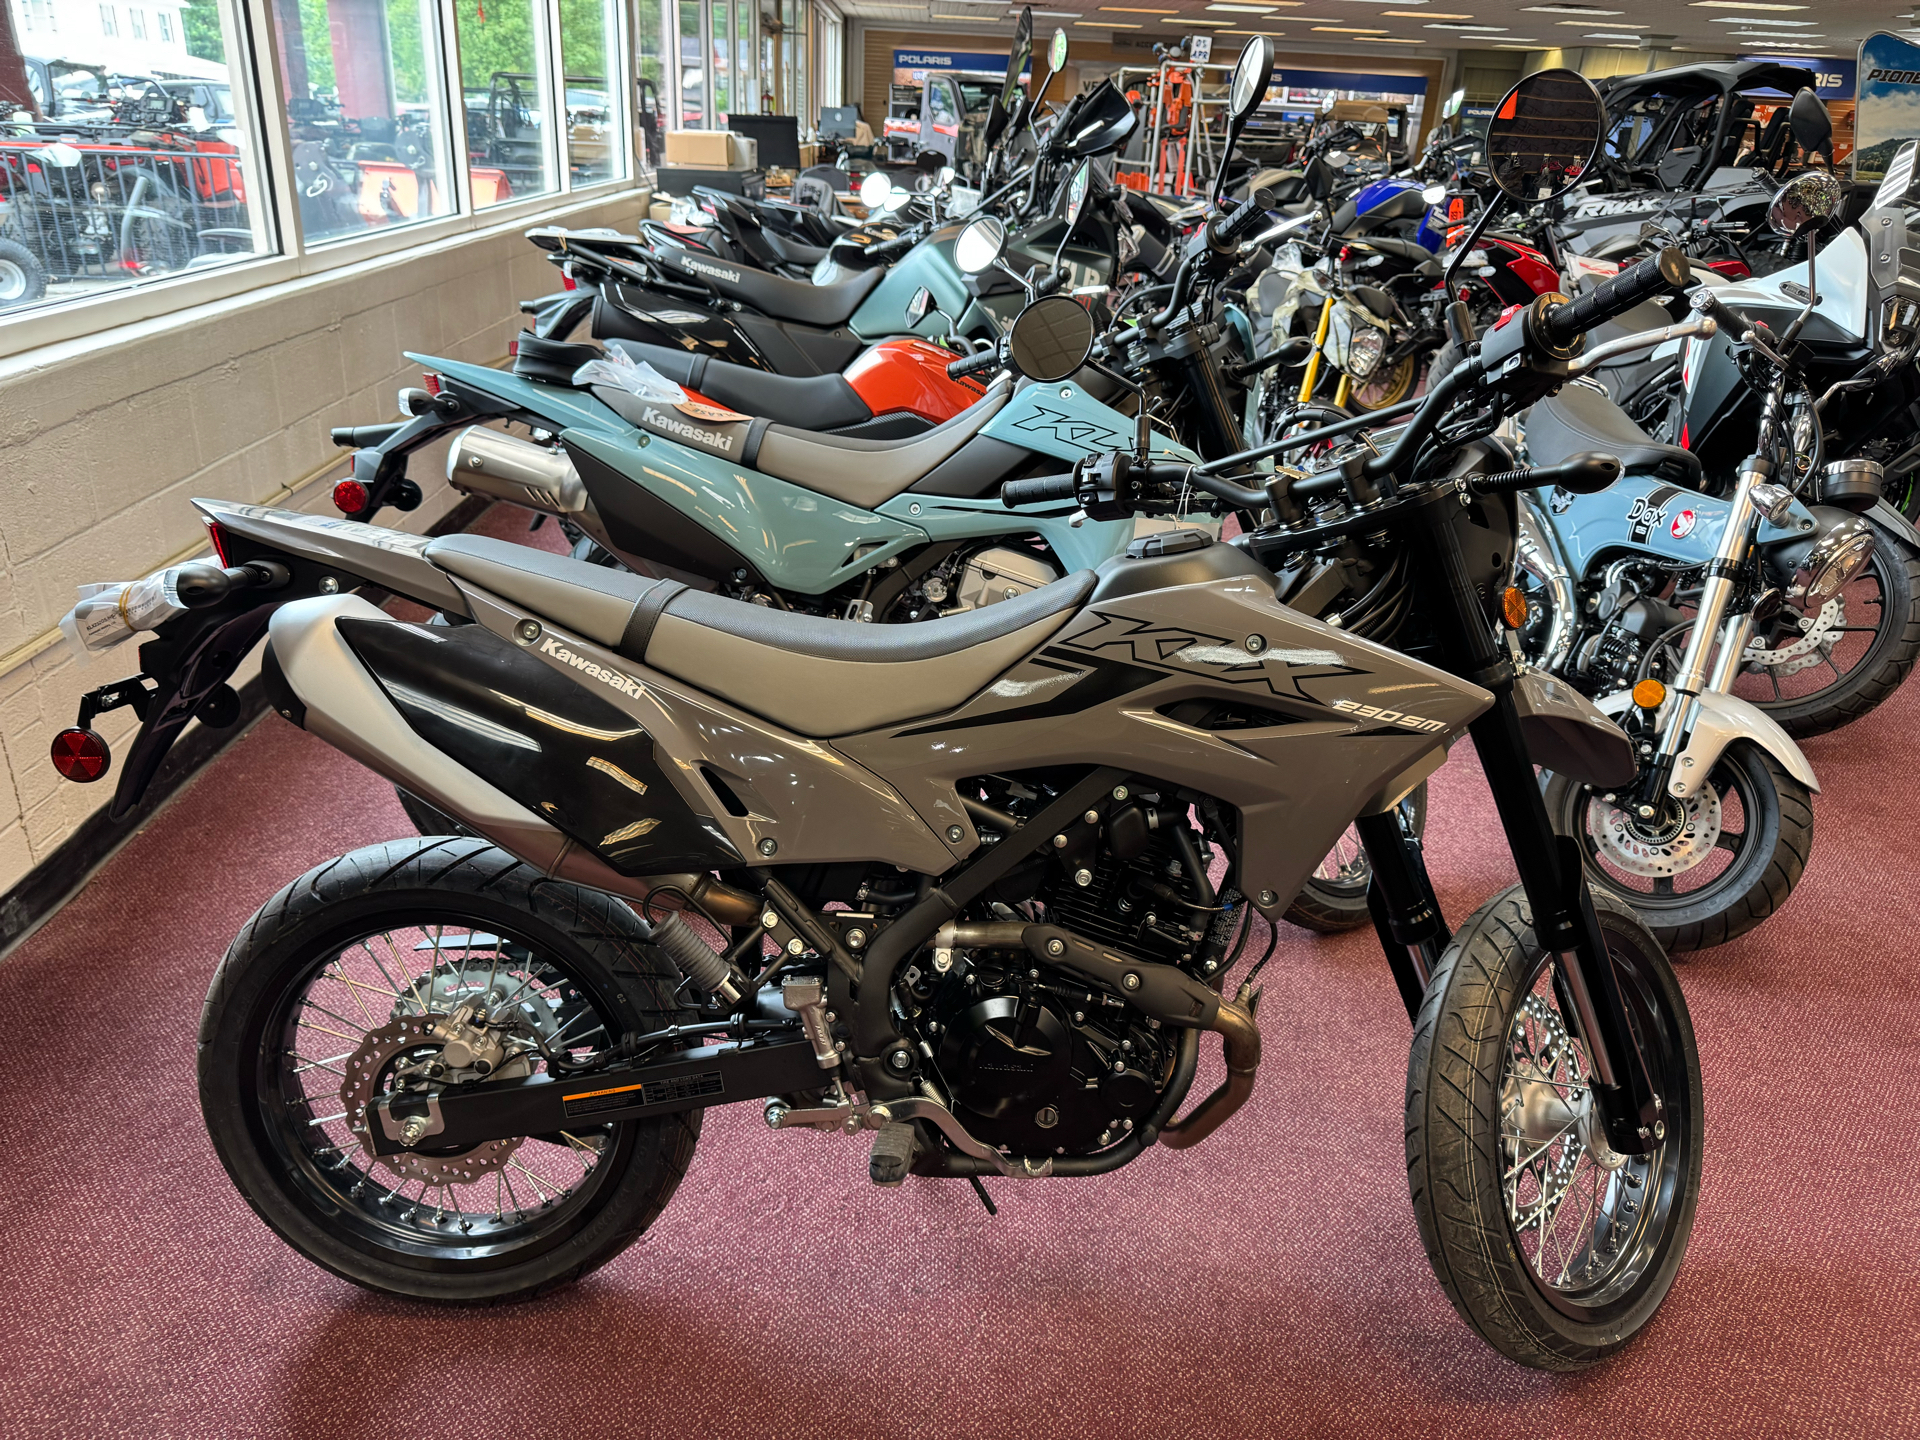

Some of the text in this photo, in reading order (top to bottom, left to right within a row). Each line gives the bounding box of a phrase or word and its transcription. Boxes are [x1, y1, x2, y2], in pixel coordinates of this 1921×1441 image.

[898, 54, 952, 66] POLARIS
[1574, 199, 1660, 218] RMAX
[680, 255, 741, 284] Kawasaki
[641, 406, 734, 451] Kawasaki
[1627, 497, 1668, 527] Dax
[539, 637, 647, 701] Kawasaki
[1058, 609, 1375, 707] KLX
[1332, 699, 1447, 732] 230SM
